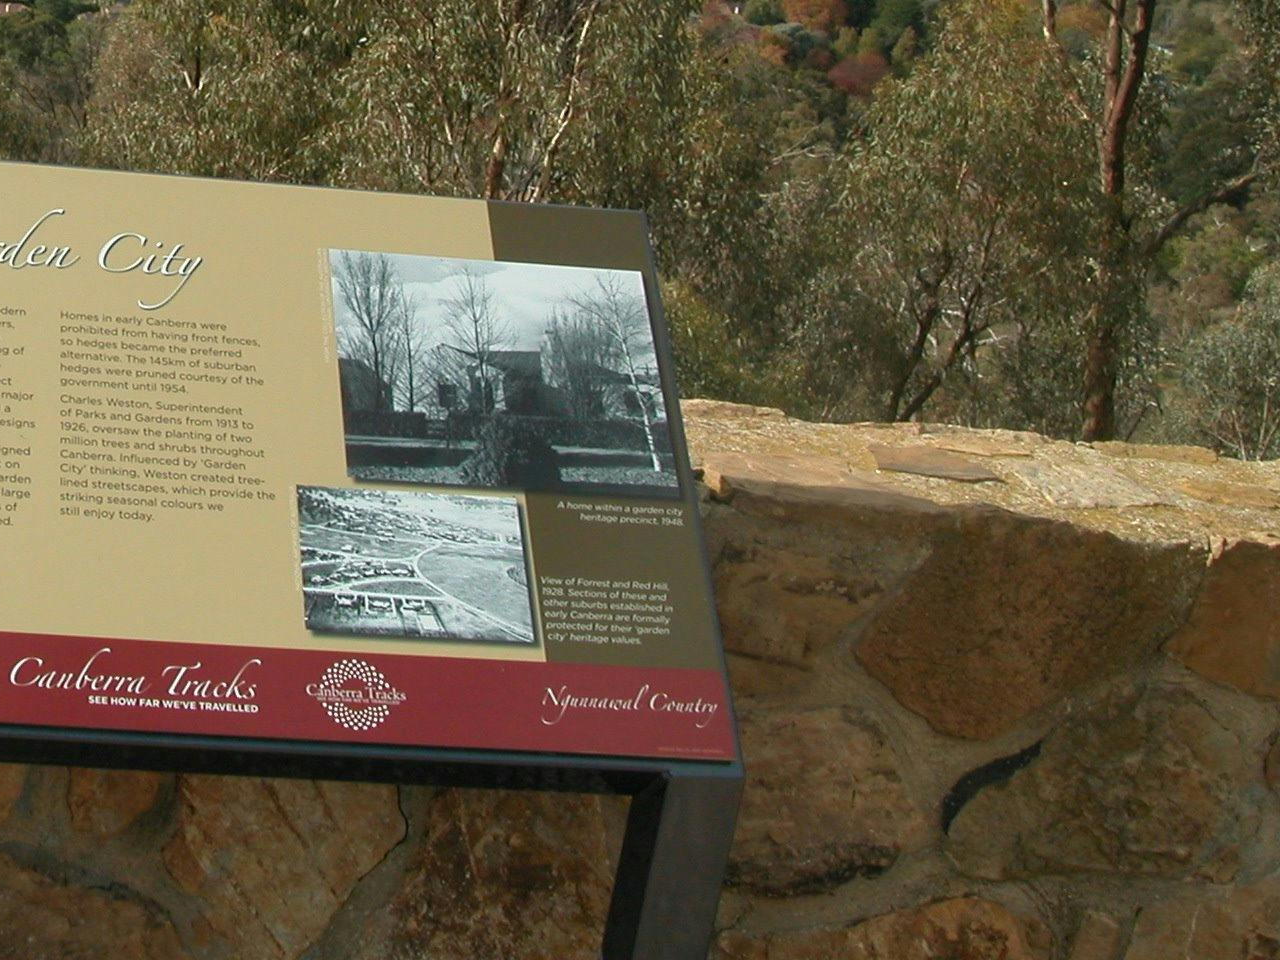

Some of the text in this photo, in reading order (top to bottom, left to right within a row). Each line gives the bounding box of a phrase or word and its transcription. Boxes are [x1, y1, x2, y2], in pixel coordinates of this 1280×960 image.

[97, 232, 203, 310] City
[60, 310, 227, 331] Homes in early Canberra were
[60, 325, 118, 336] prohibited
[121, 328, 148, 338] from
[150, 330, 188, 343] having
[191, 332, 218, 343] front
[12, 346, 24, 355] of
[60, 337, 242, 358] so hedges became the preferred
[127, 354, 146, 364] The
[150, 356, 186, 367] 145km
[188, 359, 200, 368] of
[203, 360, 256, 372] suburban
[60, 379, 128, 390] government
[131, 382, 157, 392] until
[60, 395, 102, 406] Charles
[155, 401, 243, 416] Superintendent
[60, 436, 265, 458] million trees and shrubs throughout
[119, 453, 180, 466] Influenced
[182, 458, 197, 469] by
[144, 469, 187, 480] Weston
[189, 474, 234, 483] created
[237, 475, 266, 485] tree-
[60, 477, 88, 488] lined
[171, 485, 206, 496] which
[208, 489, 253, 499] provide
[256, 491, 276, 500] the
[60, 493, 224, 512] striking seasonal colours we
[60, 507, 80, 517] still
[82, 509, 114, 521] enjoy
[10, 648, 262, 700] Canberra Tracks
[306, 683, 407, 700] Canberra Tracks
[88, 694, 259, 713] SEE HOW FAR WE'VE TRAVELLED
[541, 684, 718, 728] Ngunnawal Country
